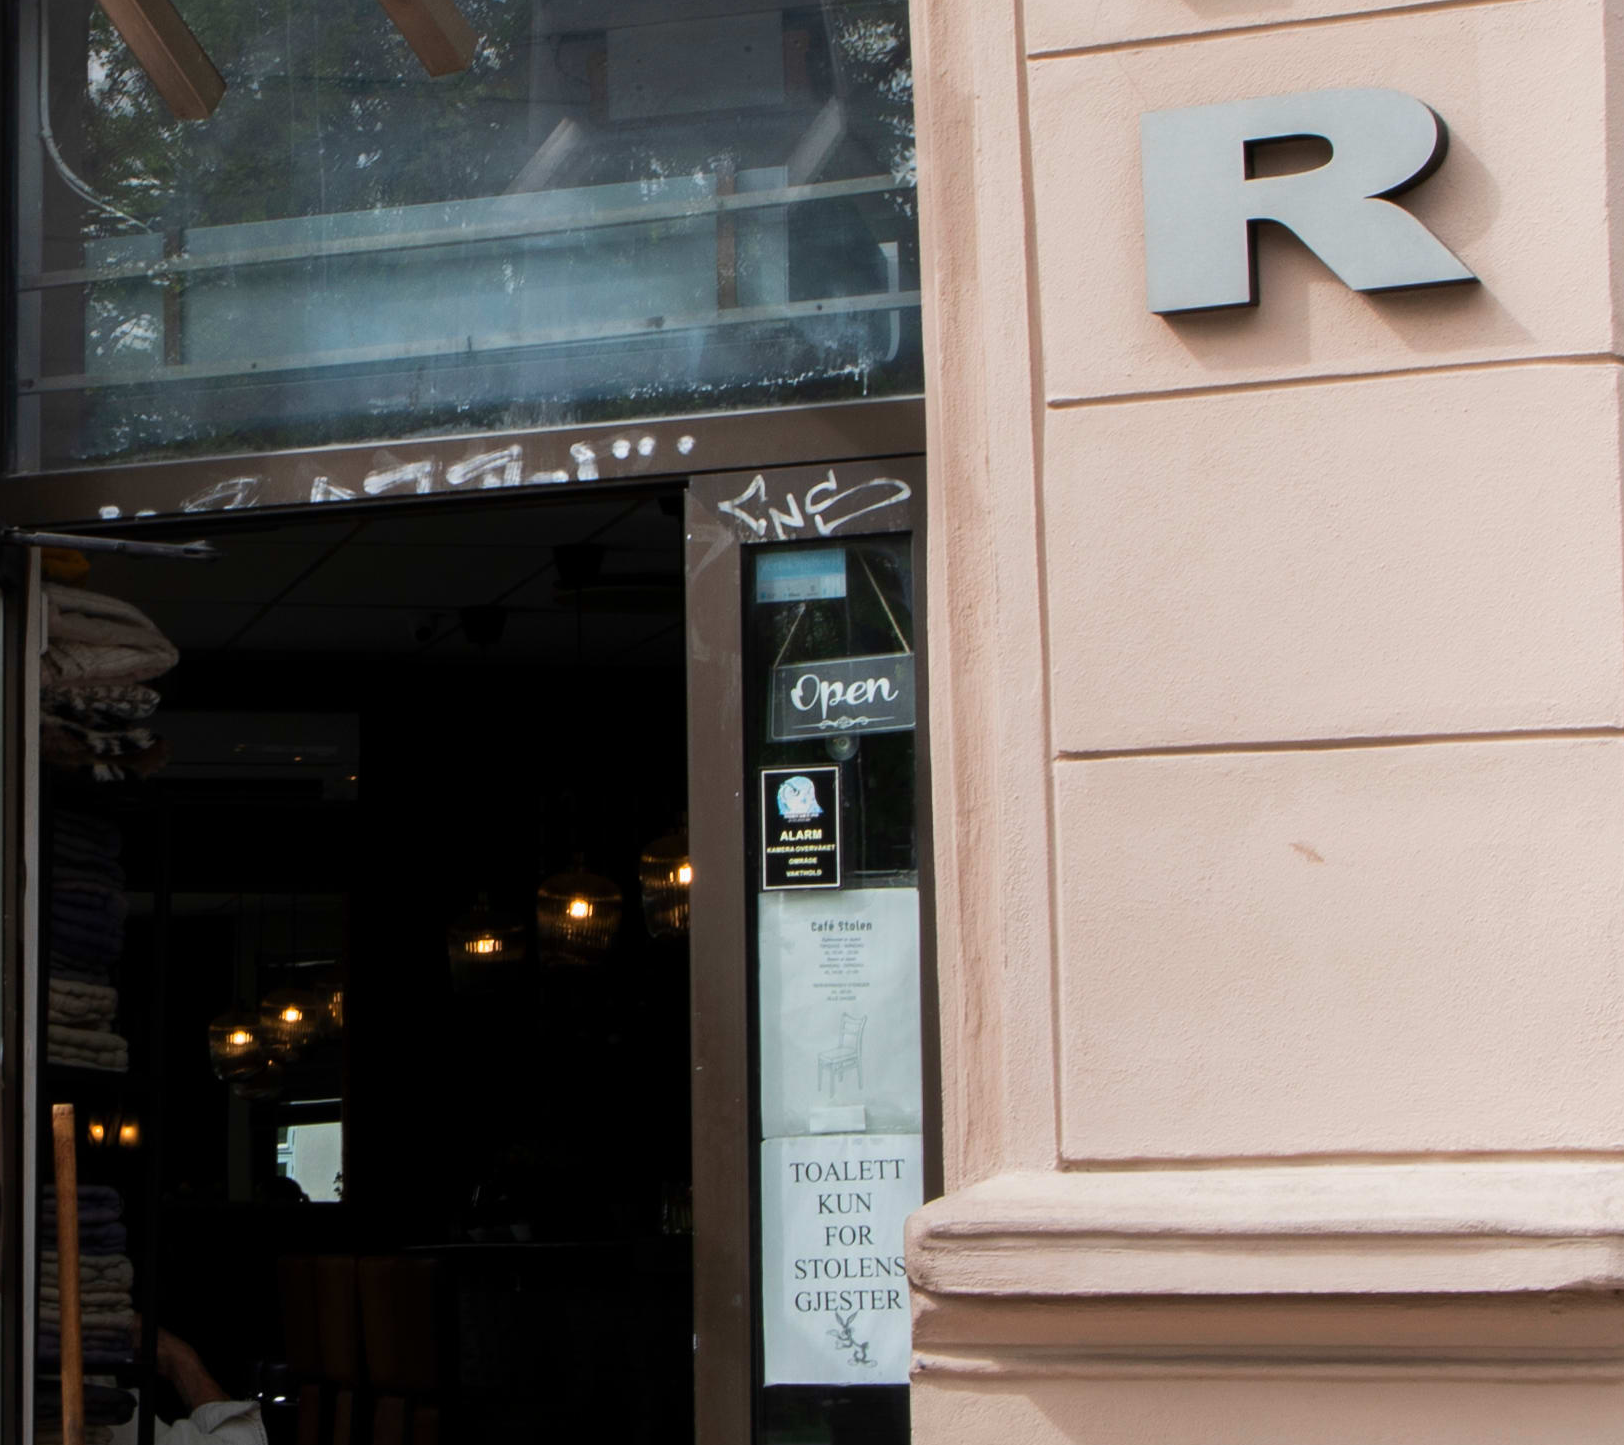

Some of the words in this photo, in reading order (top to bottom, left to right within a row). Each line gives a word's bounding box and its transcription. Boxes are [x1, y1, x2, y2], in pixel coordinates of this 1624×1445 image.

[791, 674, 899, 719] Open
[779, 829, 823, 841] ALARM
[811, 919, 835, 932] Café
[838, 920, 873, 932] Stolen
[789, 1159, 905, 1183] TOALETT
[817, 1192, 874, 1215] KUN
[823, 1225, 875, 1248] FOR
[794, 1256, 907, 1281] STOLENS
[794, 1289, 903, 1313] GJESTER
